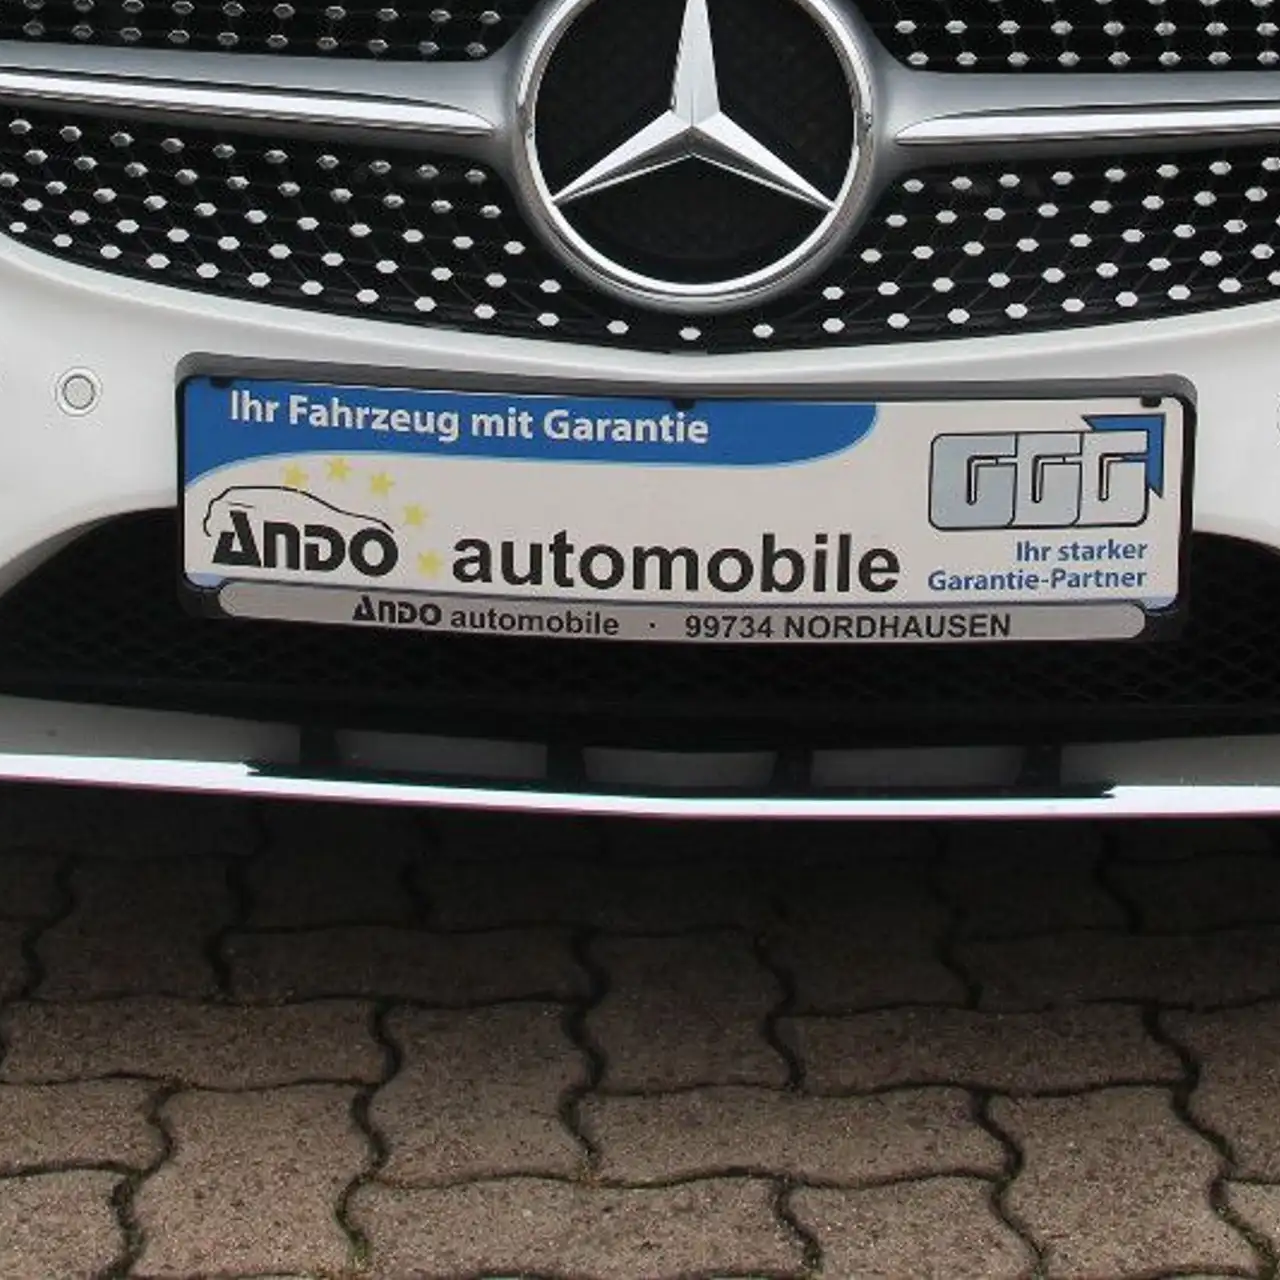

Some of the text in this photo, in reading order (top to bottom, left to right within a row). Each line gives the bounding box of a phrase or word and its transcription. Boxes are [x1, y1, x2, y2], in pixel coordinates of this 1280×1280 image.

[231, 389, 710, 444] Ihr Fahrzeug mit Garantie
[452, 530, 901, 593] automobile
[1016, 538, 1148, 562] Ihr starker
[927, 568, 1148, 591] Garantie-Partner
[450, 608, 620, 637] automobile
[685, 615, 775, 639] 99734
[783, 614, 1011, 639] NORDHAUSEN
